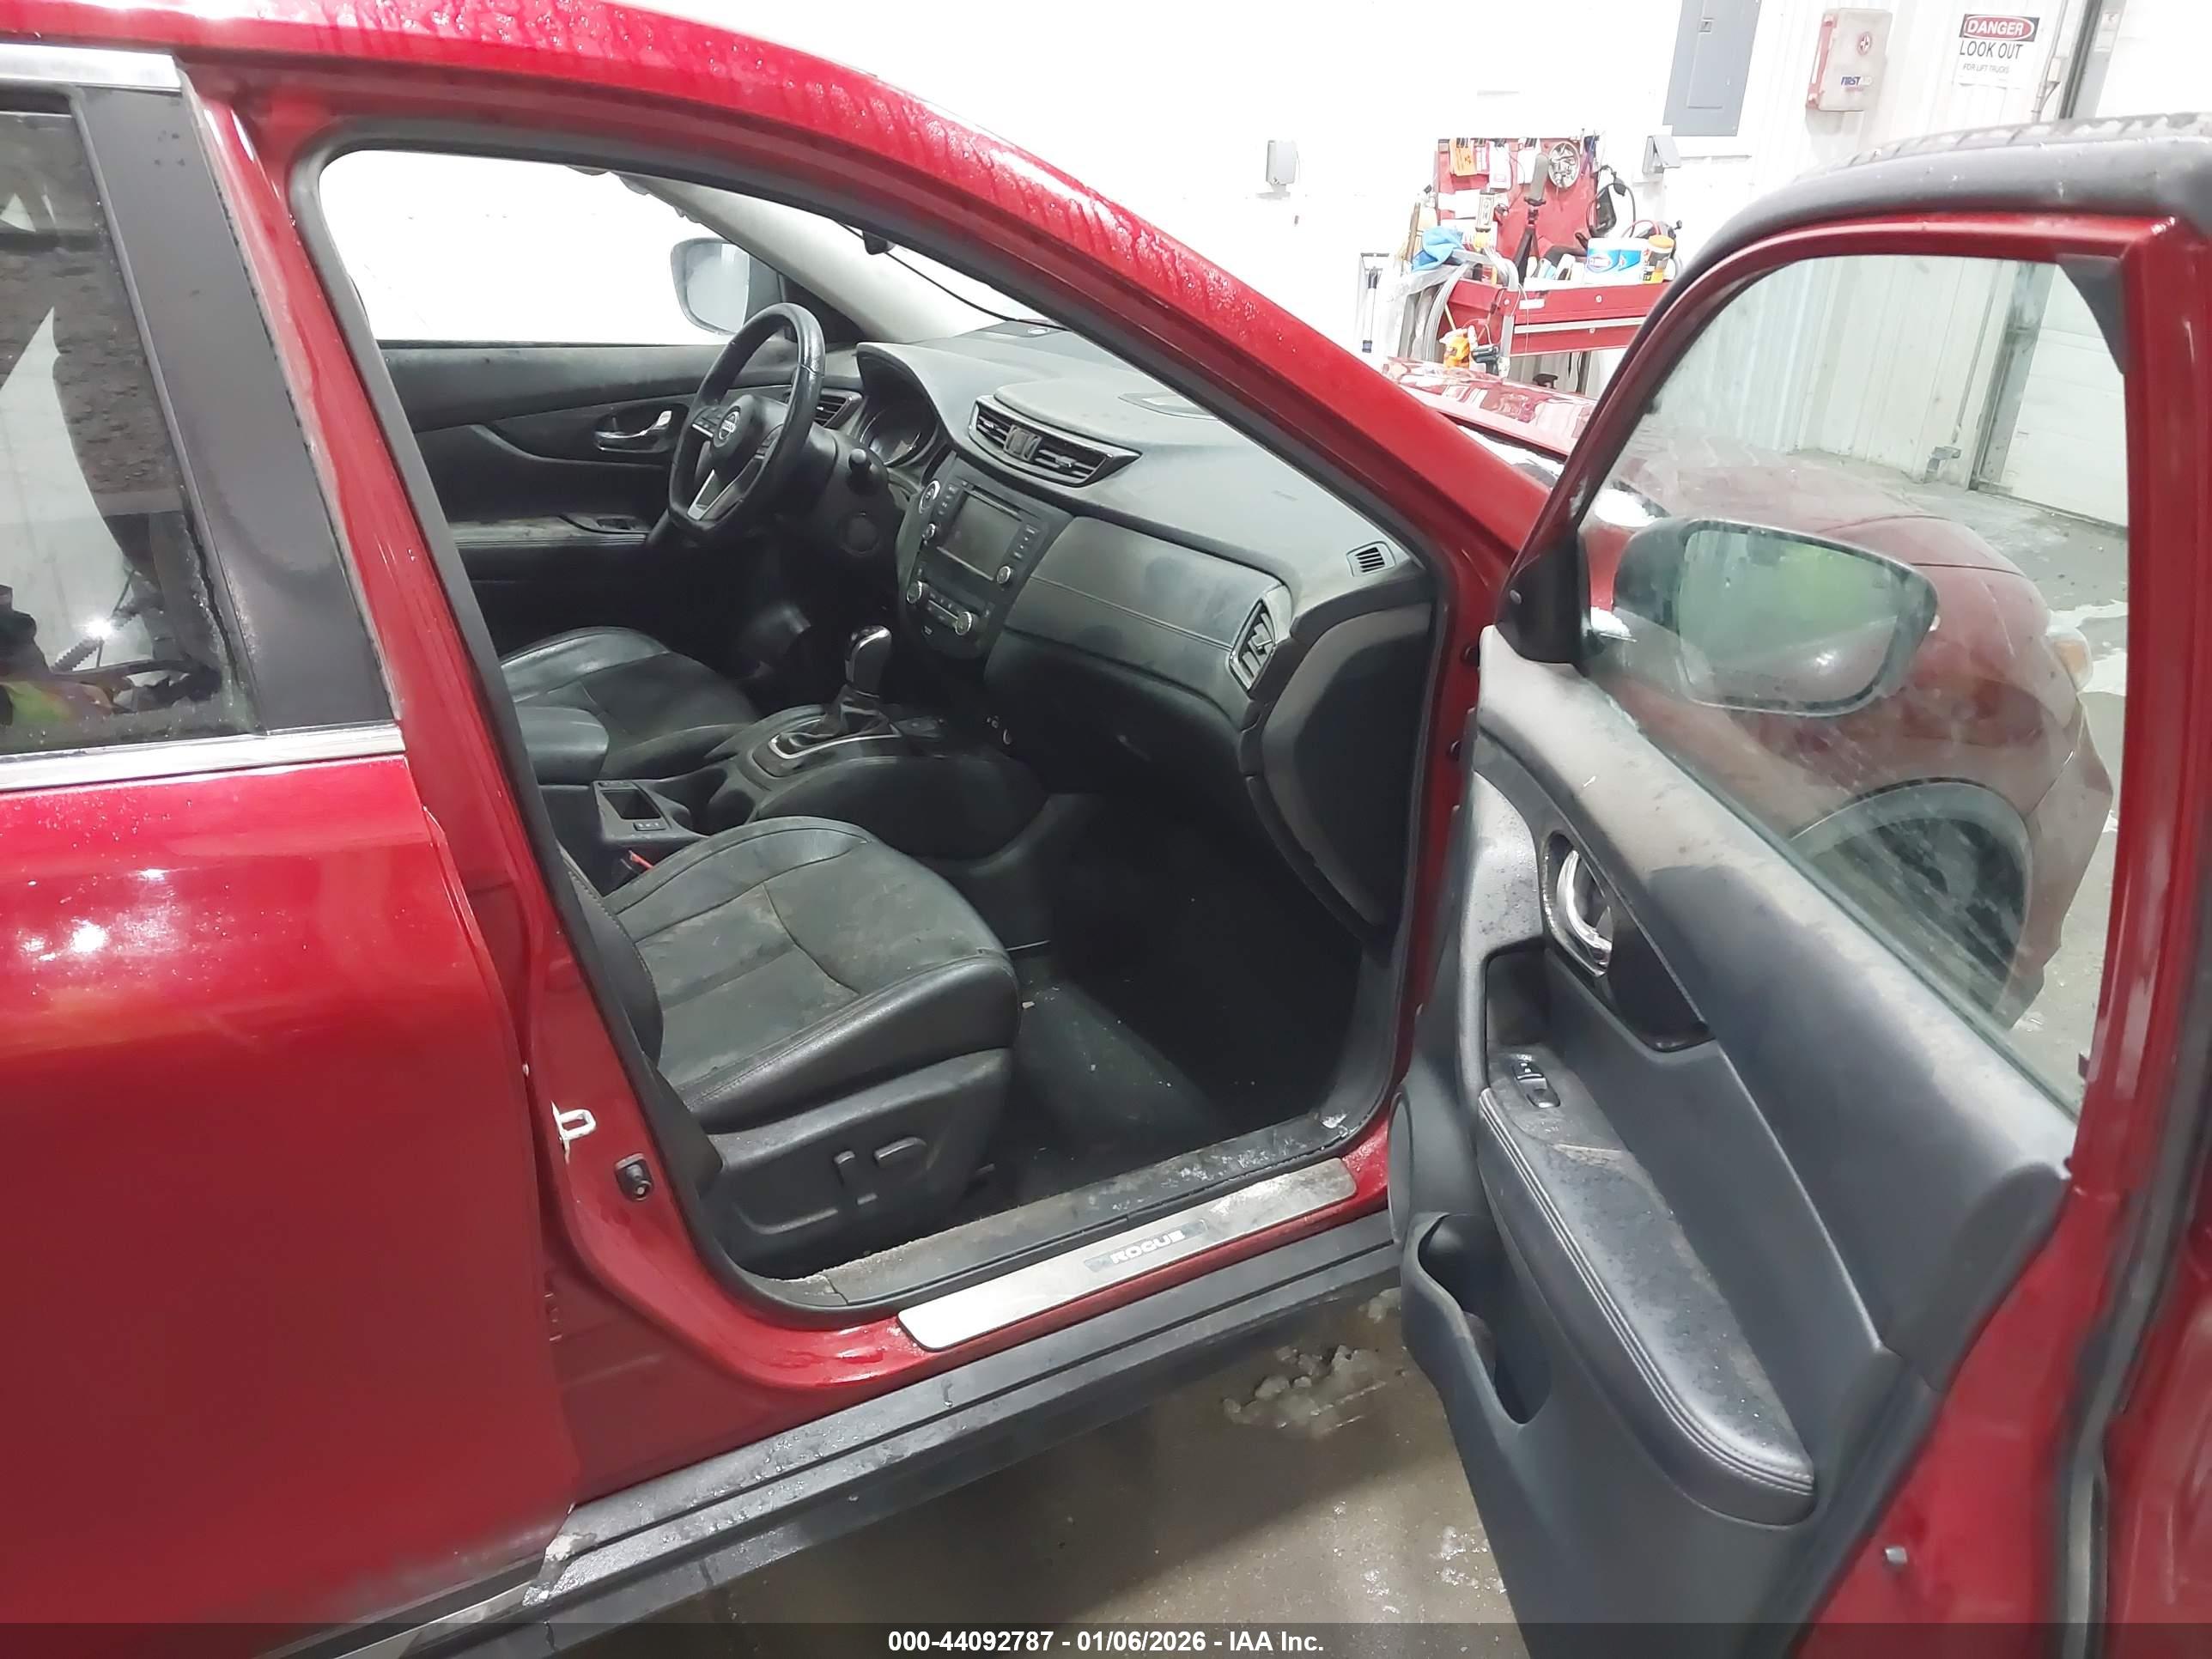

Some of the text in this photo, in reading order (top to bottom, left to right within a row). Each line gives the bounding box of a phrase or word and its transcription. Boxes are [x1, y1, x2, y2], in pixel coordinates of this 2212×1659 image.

[1967, 20, 2024, 36] DANGER
[1960, 40, 2023, 59] LOOK OUT
[1976, 64, 1989, 72] LIFT
[1841, 76, 1861, 86] FIRST
[1110, 1230, 1185, 1264] ROGUE
